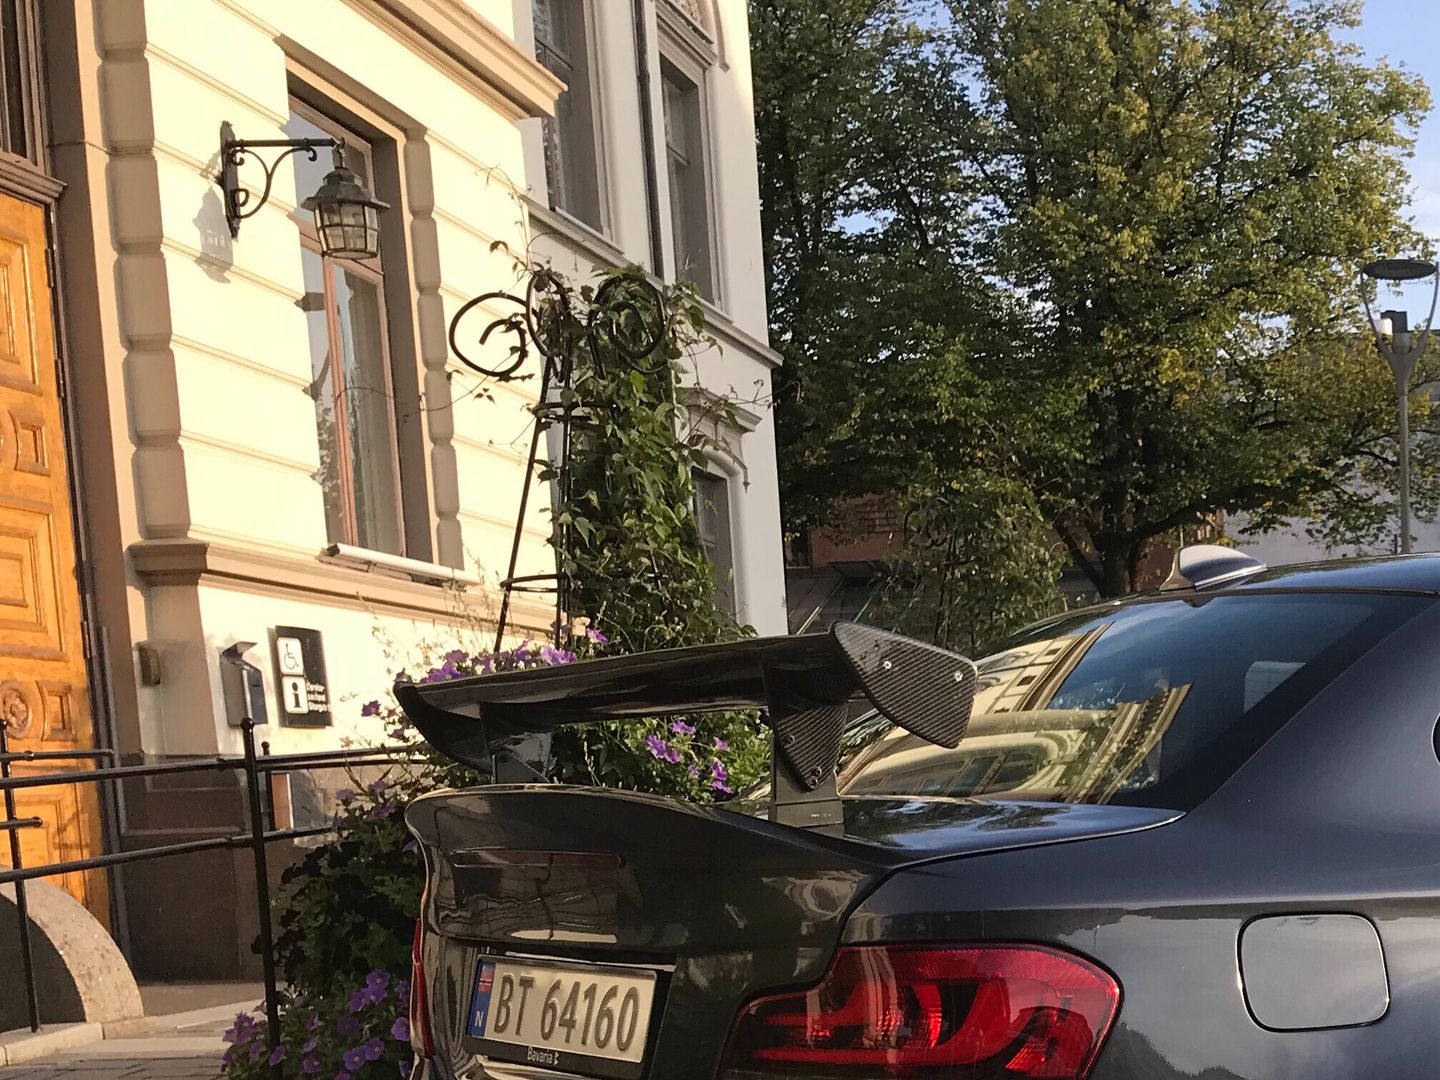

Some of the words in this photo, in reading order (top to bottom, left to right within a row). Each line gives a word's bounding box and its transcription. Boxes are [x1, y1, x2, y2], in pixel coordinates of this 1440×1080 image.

[474, 1010, 484, 1028] N
[494, 974, 536, 1036] BT
[540, 978, 641, 1052] 64160
[527, 1046, 553, 1064] Bavaria
